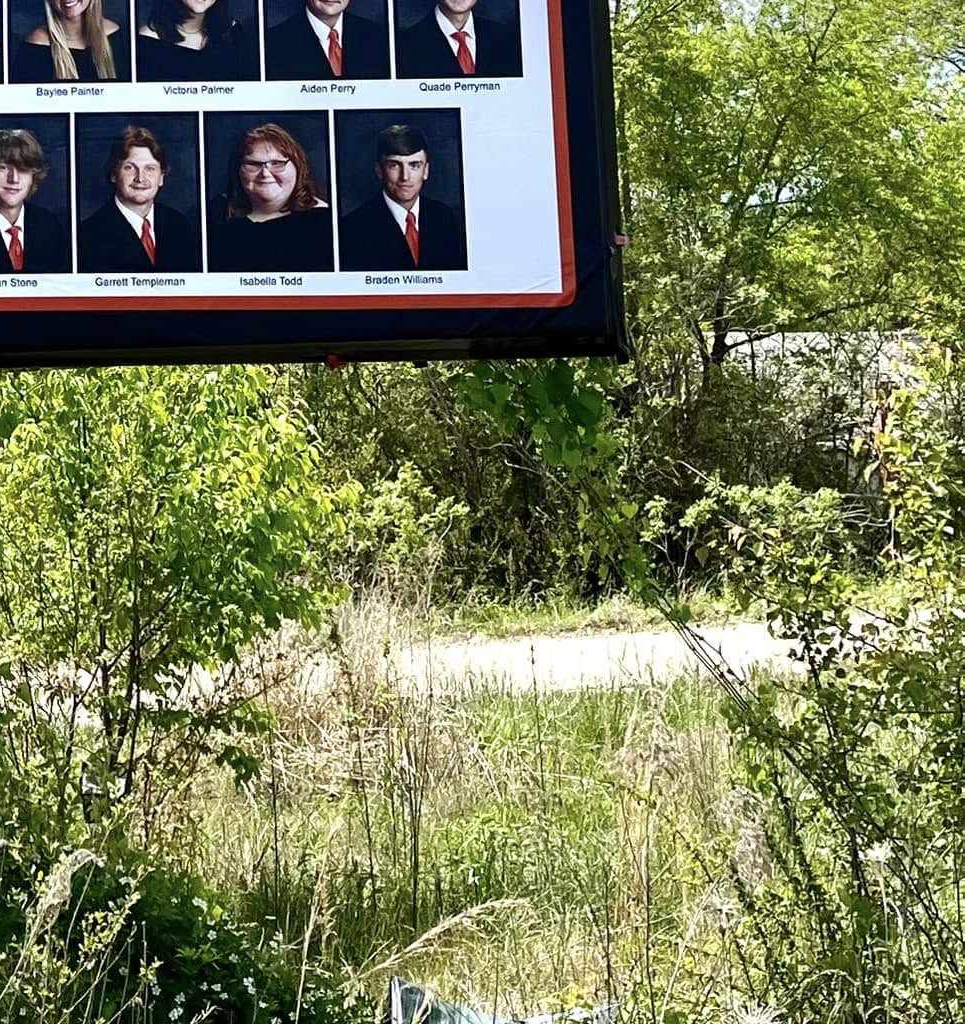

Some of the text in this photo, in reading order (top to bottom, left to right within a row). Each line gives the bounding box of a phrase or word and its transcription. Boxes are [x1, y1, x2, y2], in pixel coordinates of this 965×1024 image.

[35, 86, 105, 99] Baylee Painter
[162, 84, 235, 96] Victoria Palmer
[299, 83, 357, 96] Aiden Perry
[418, 81, 501, 94] Quade Perryman
[9, 277, 38, 288] Stone
[94, 276, 186, 289] Garrett Templeman
[239, 275, 303, 287] Isabella Todd
[364, 274, 444, 286] Braden Williams
